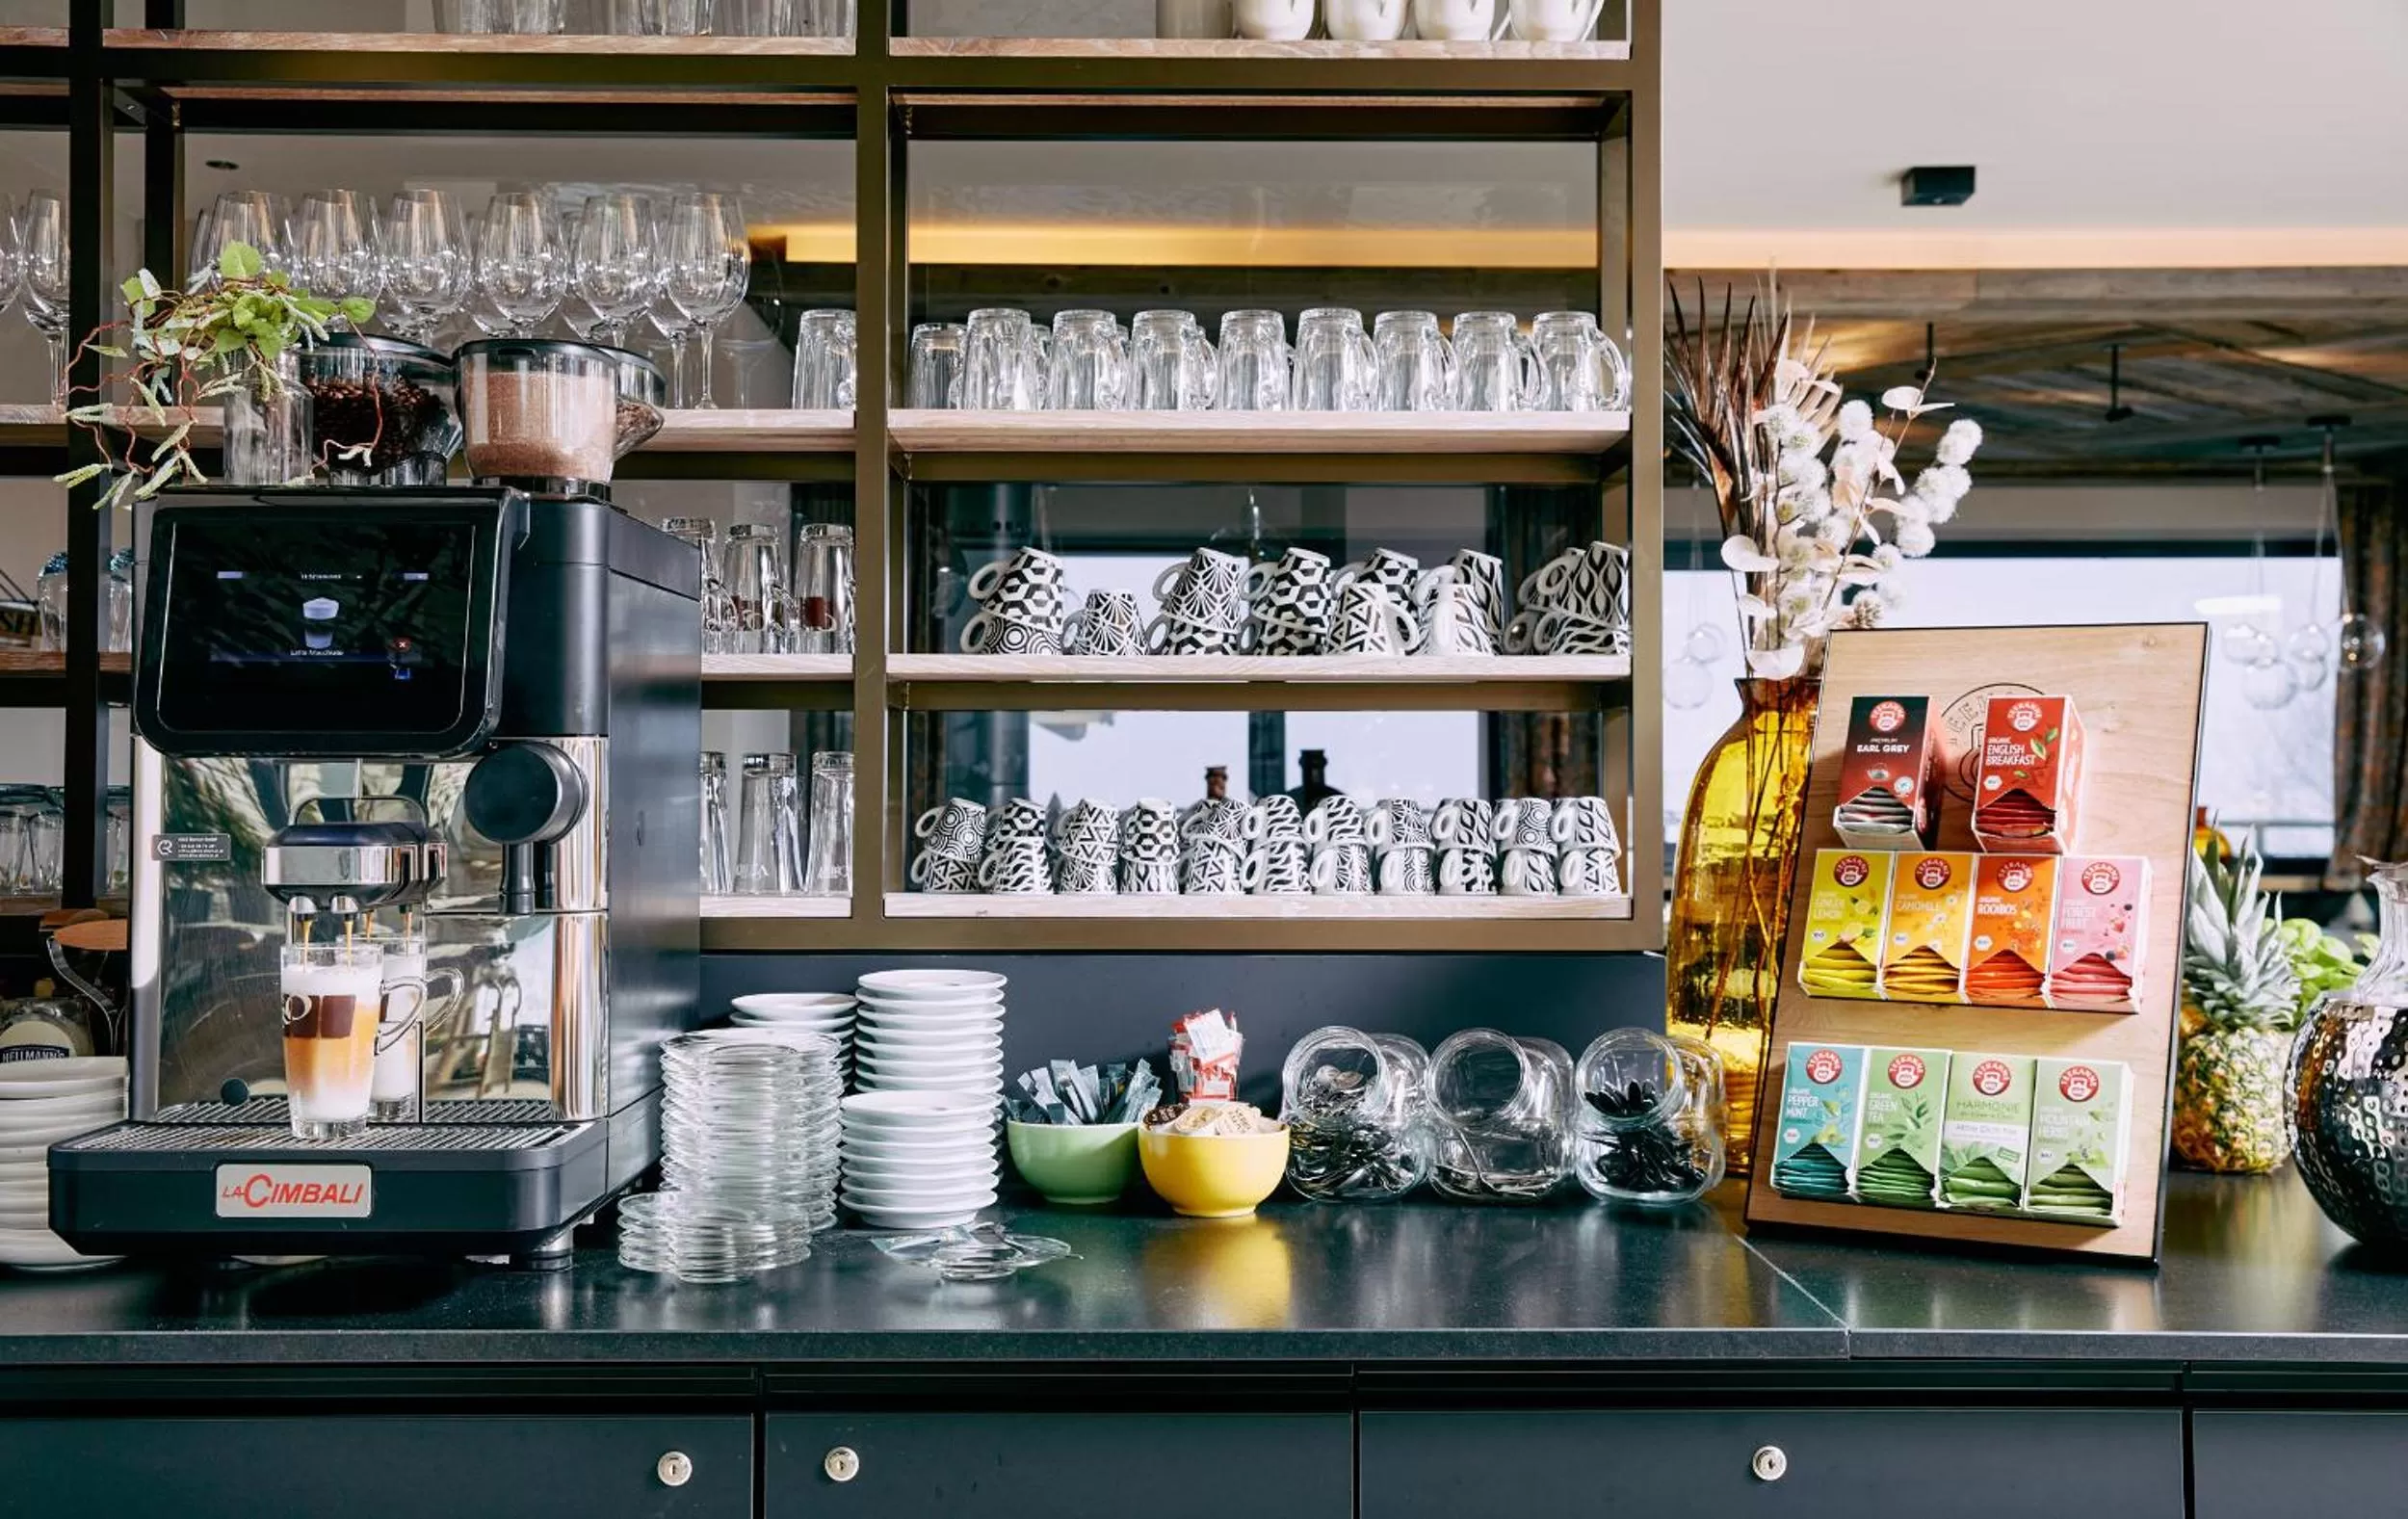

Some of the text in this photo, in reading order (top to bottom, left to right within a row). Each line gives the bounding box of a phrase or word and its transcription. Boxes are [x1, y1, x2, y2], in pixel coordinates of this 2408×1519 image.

[1857, 744, 1911, 753] EARL GREY
[1987, 744, 2026, 755] ENGLISH
[1985, 754, 2036, 767] BREAKFAST
[1788, 1095, 1819, 1107] PEPPER
[222, 1173, 364, 1208] LA CIMBALI
